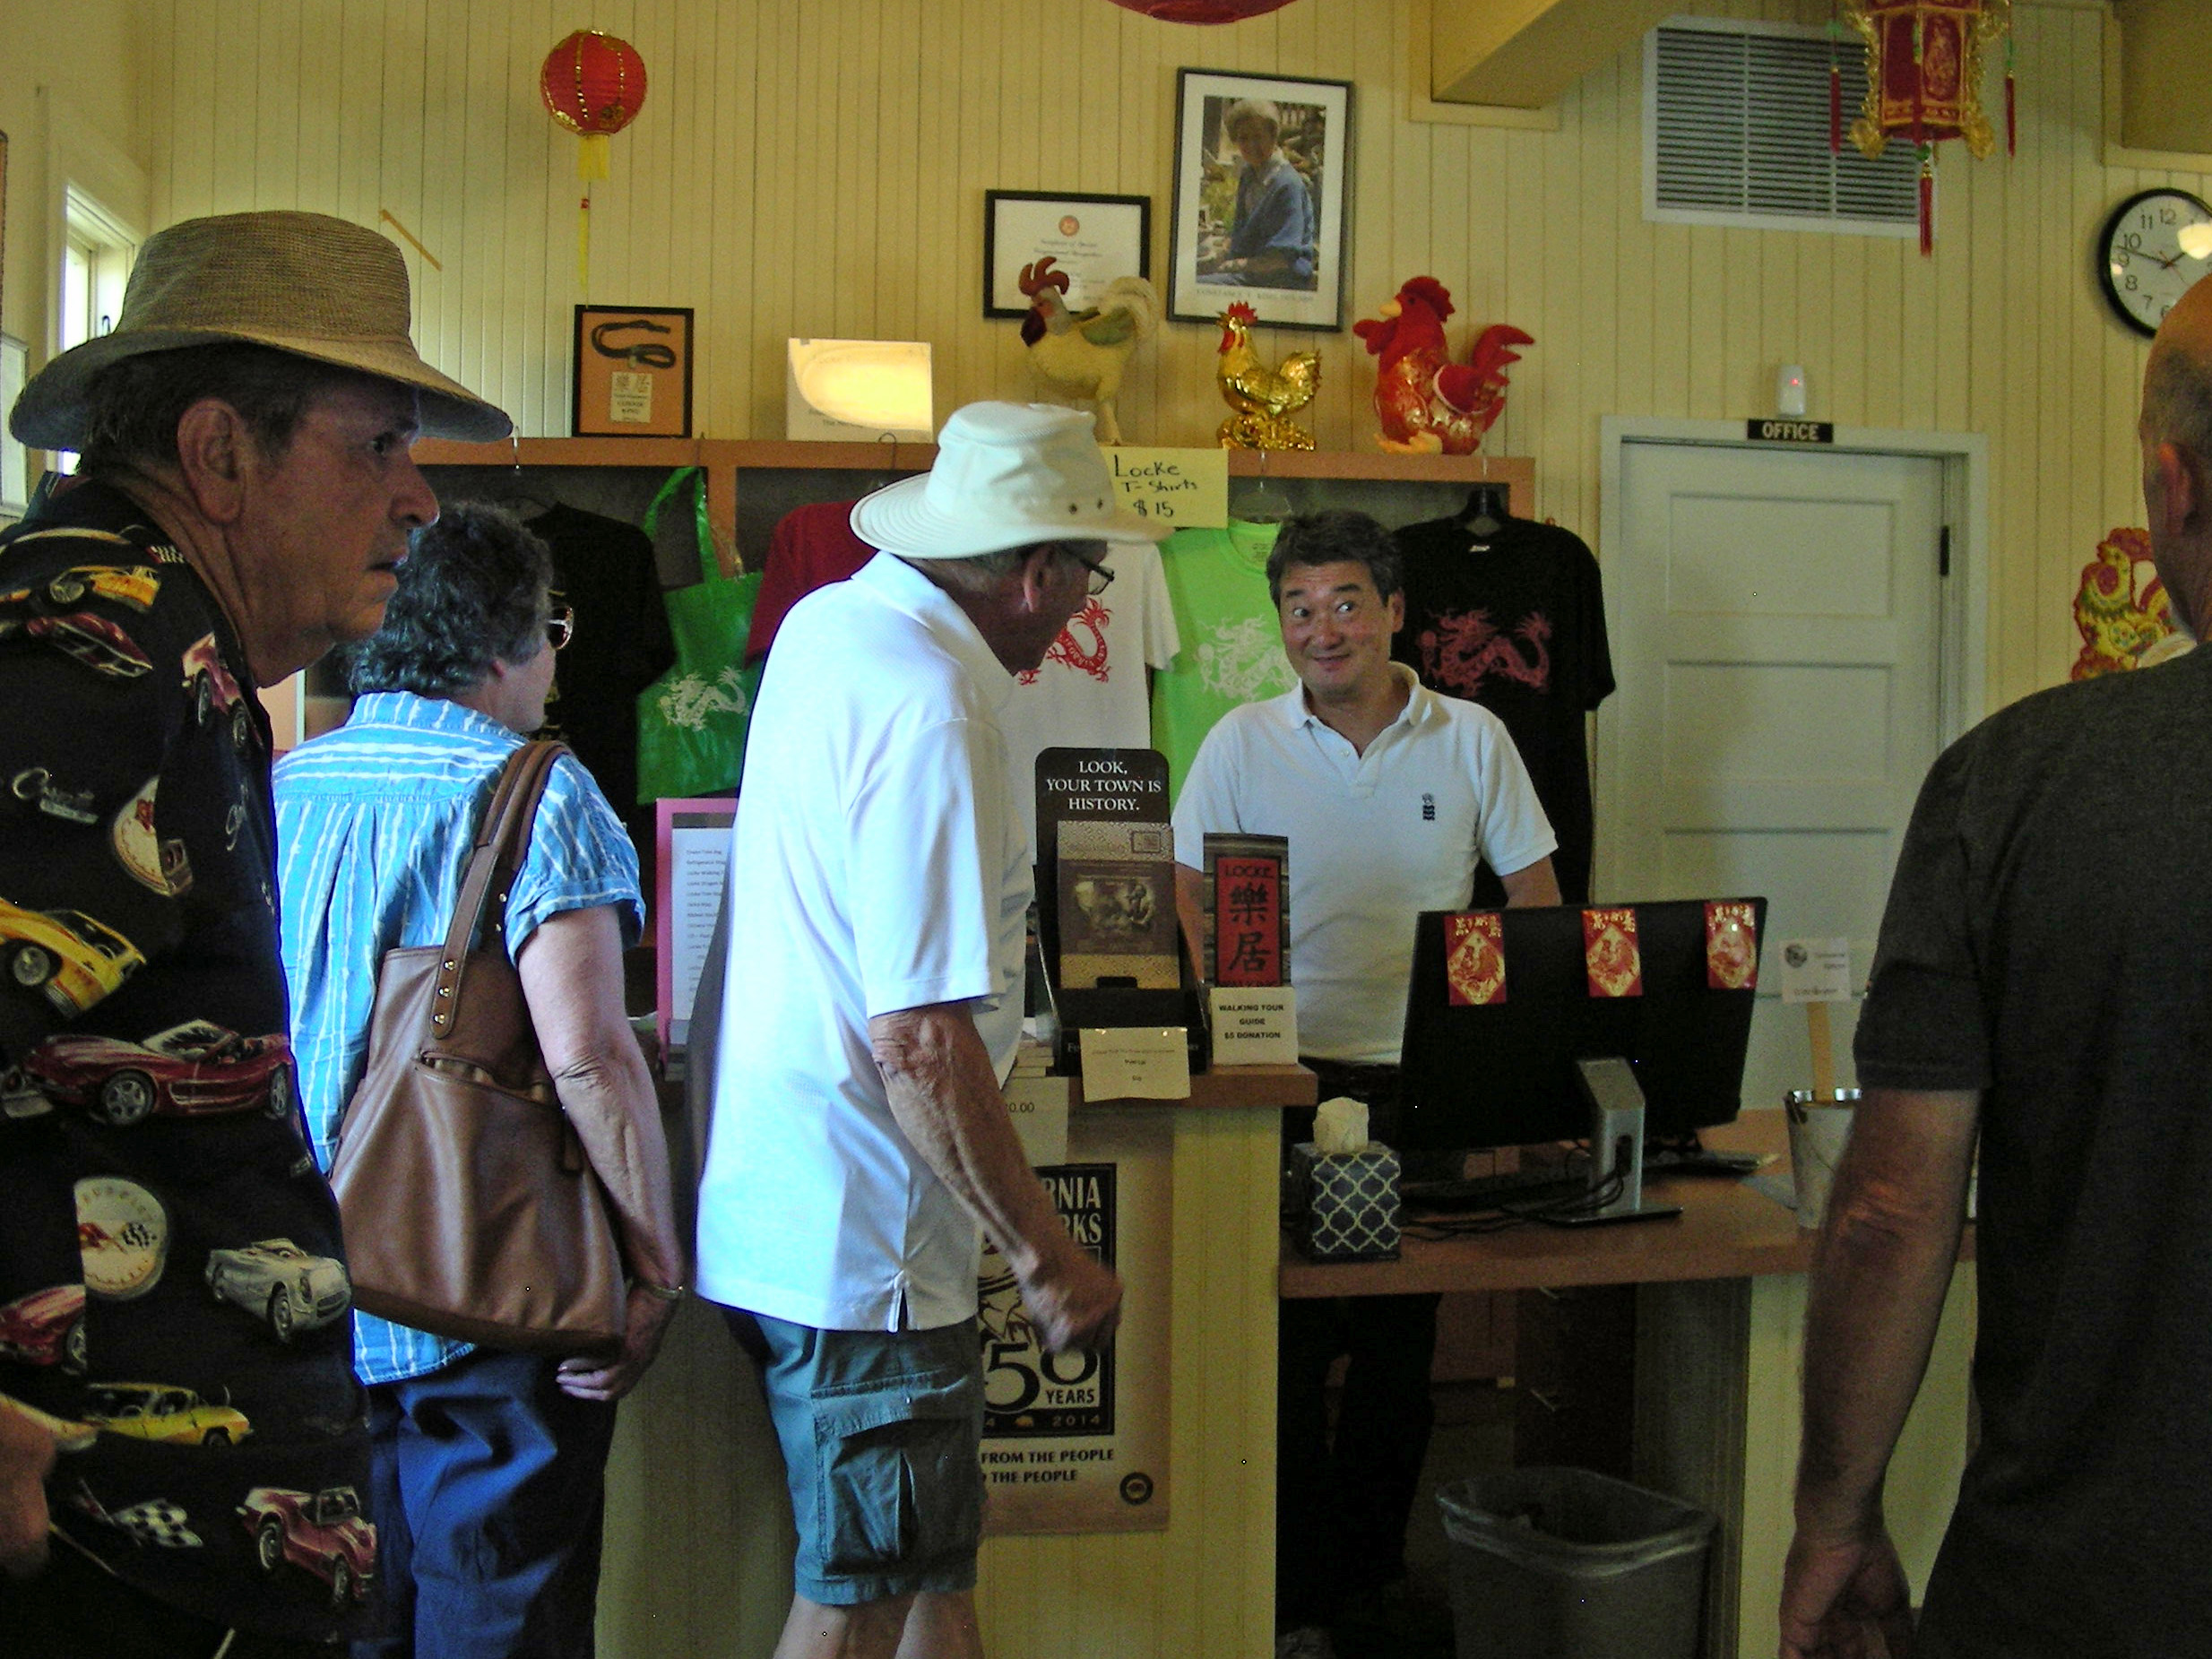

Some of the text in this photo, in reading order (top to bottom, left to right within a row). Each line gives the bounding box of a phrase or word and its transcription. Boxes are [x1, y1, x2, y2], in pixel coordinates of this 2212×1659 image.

[2140, 214, 2153, 229] 11
[2159, 209, 2176, 224] 12
[2124, 232, 2142, 249] 10
[2117, 252, 2130, 267] 9
[2125, 275, 2138, 291] 8
[2143, 294, 2153, 310] 7
[1762, 421, 1819, 440] OFFICE
[1078, 760, 1128, 774] LOOK,
[1046, 778, 1162, 792] YOUR TOWN IS
[1068, 797, 1140, 811] HISTORY.
[1224, 864, 1274, 879] LOCKE
[1229, 881, 1273, 973] 樂居
[1239, 1017, 1266, 1025] GUIDE
[1046, 1389, 1095, 1404] YEARS
[1051, 1414, 1101, 1428] 2014
[981, 1448, 1115, 1464] FROM THE PEOPLE
[991, 1472, 1019, 1483] THE
[1023, 1470, 1078, 1483] PEOPLE
